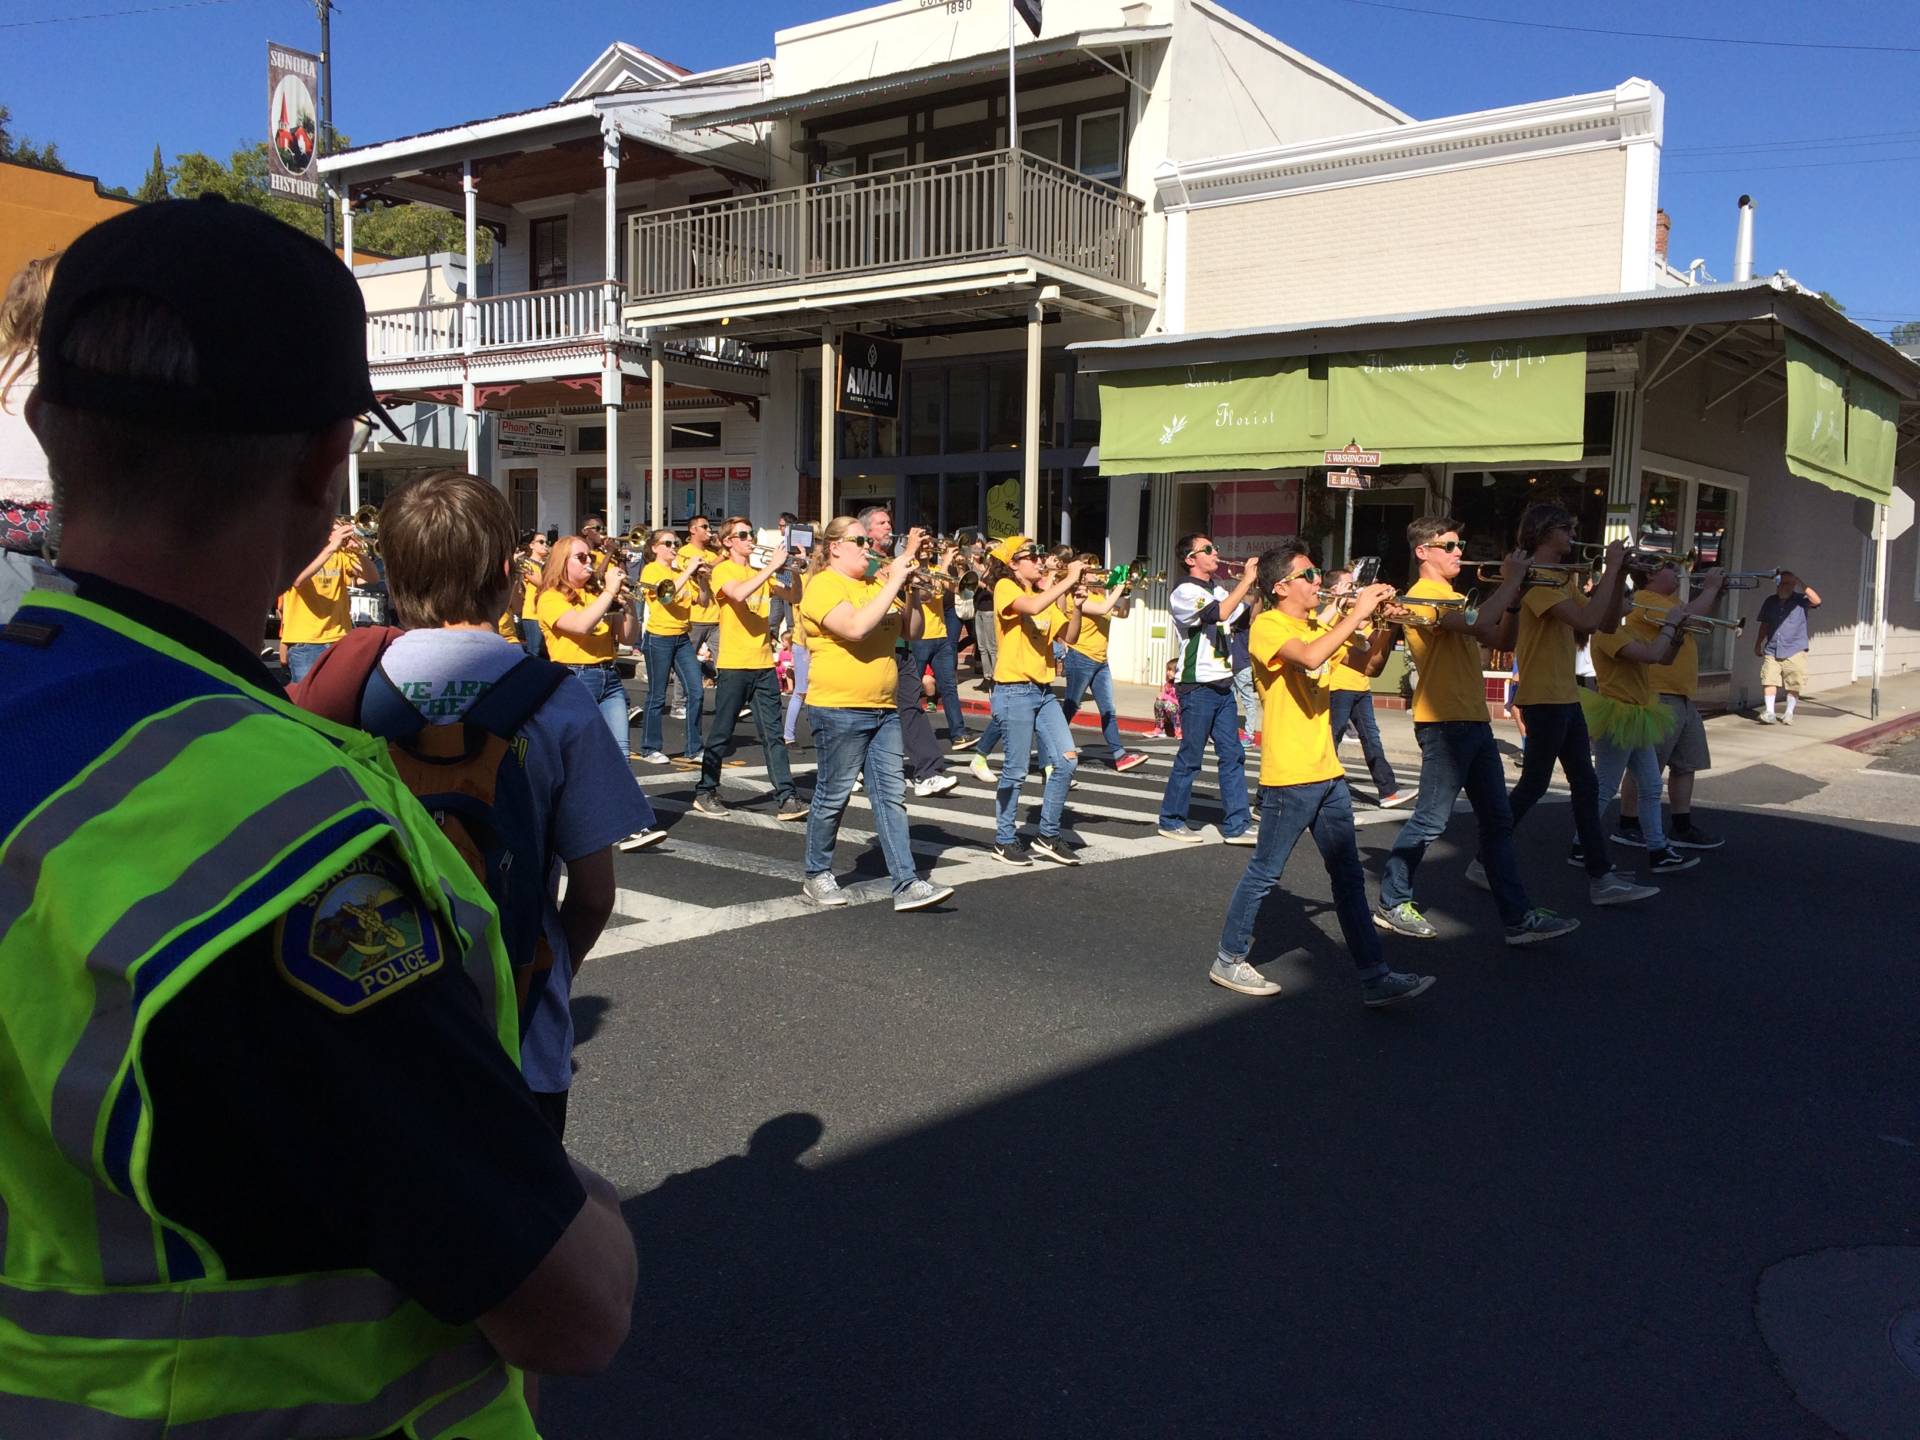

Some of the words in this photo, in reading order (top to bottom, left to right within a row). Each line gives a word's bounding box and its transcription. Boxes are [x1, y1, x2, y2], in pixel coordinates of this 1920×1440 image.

[946, 0, 972, 15] 1890
[270, 50, 317, 78] SONORA
[271, 173, 319, 199] HISTORY
[846, 366, 893, 401] AMALA
[1215, 402, 1275, 427] Florist
[502, 420, 529, 433] Phone
[535, 424, 563, 437] Smart
[1332, 453, 1377, 464] WASHINGTON
[359, 949, 430, 996] POLICE
